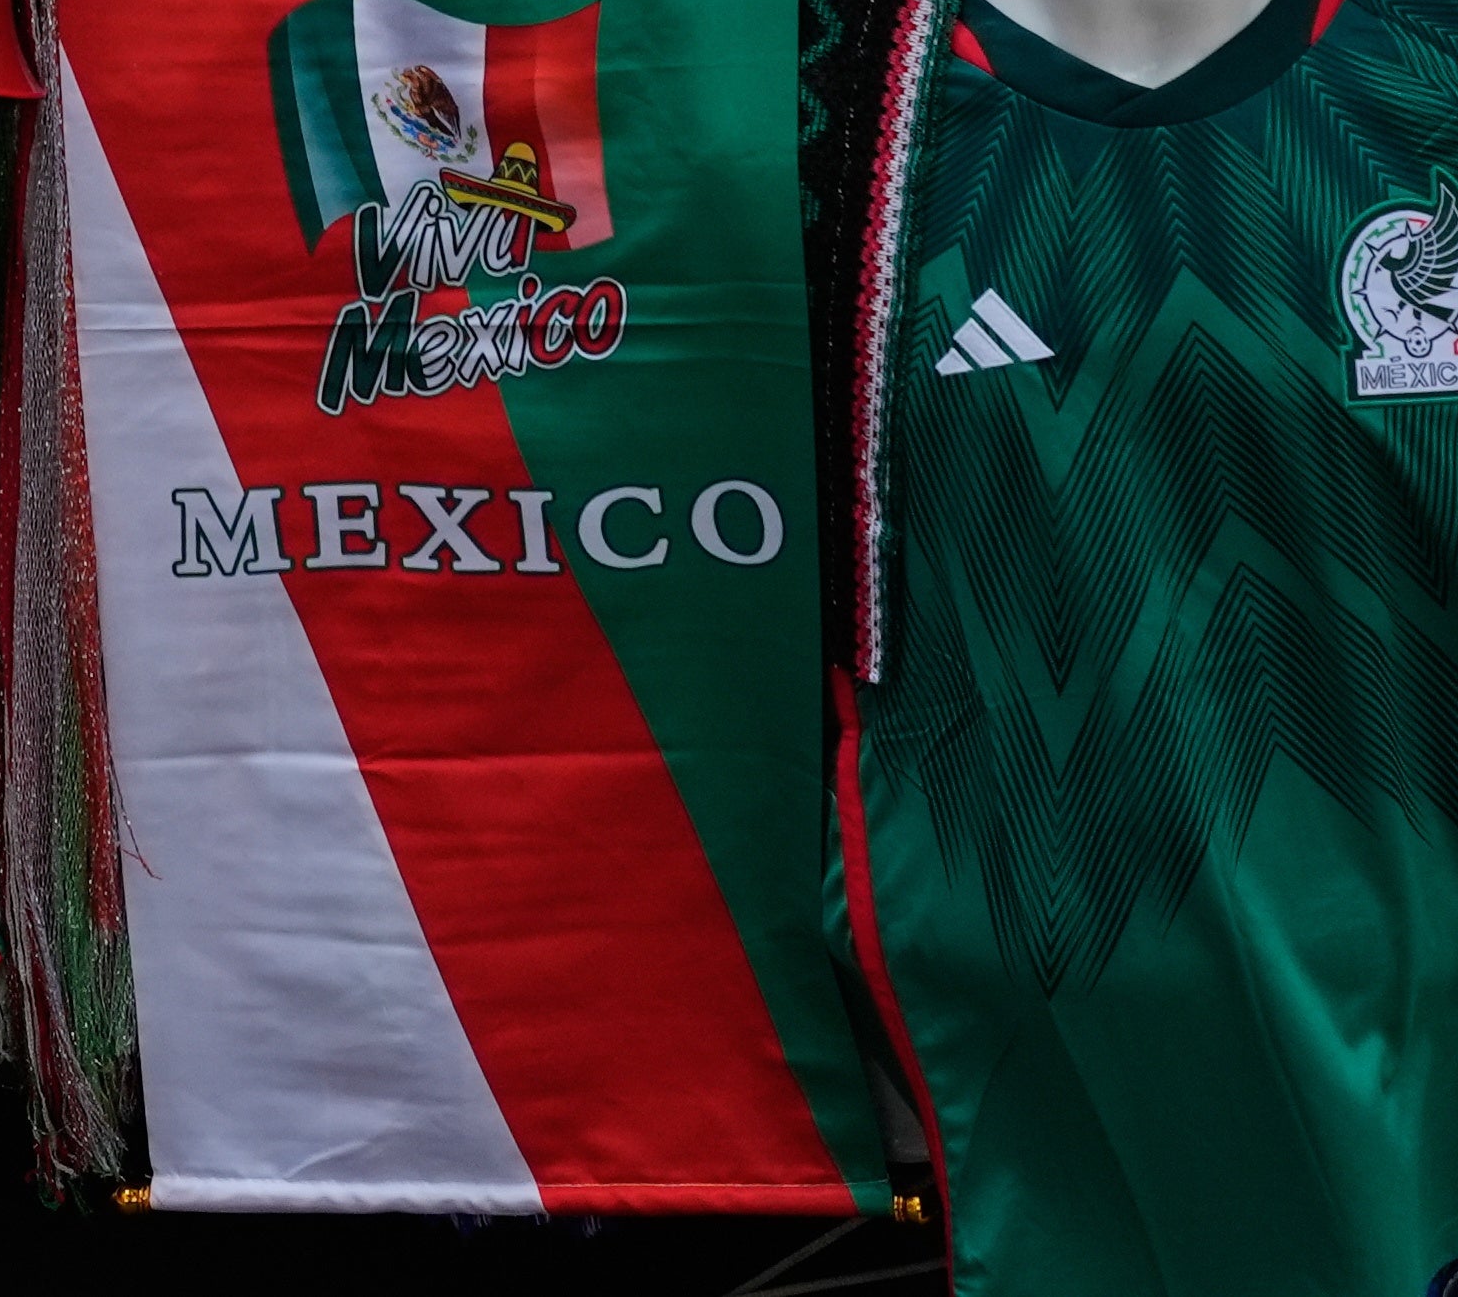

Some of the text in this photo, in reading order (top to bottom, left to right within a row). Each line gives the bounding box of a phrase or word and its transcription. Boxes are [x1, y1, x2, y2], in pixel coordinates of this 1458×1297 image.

[353, 181, 538, 300] Viva
[317, 275, 627, 415] Mexico
[171, 478, 785, 577] MEXICO
